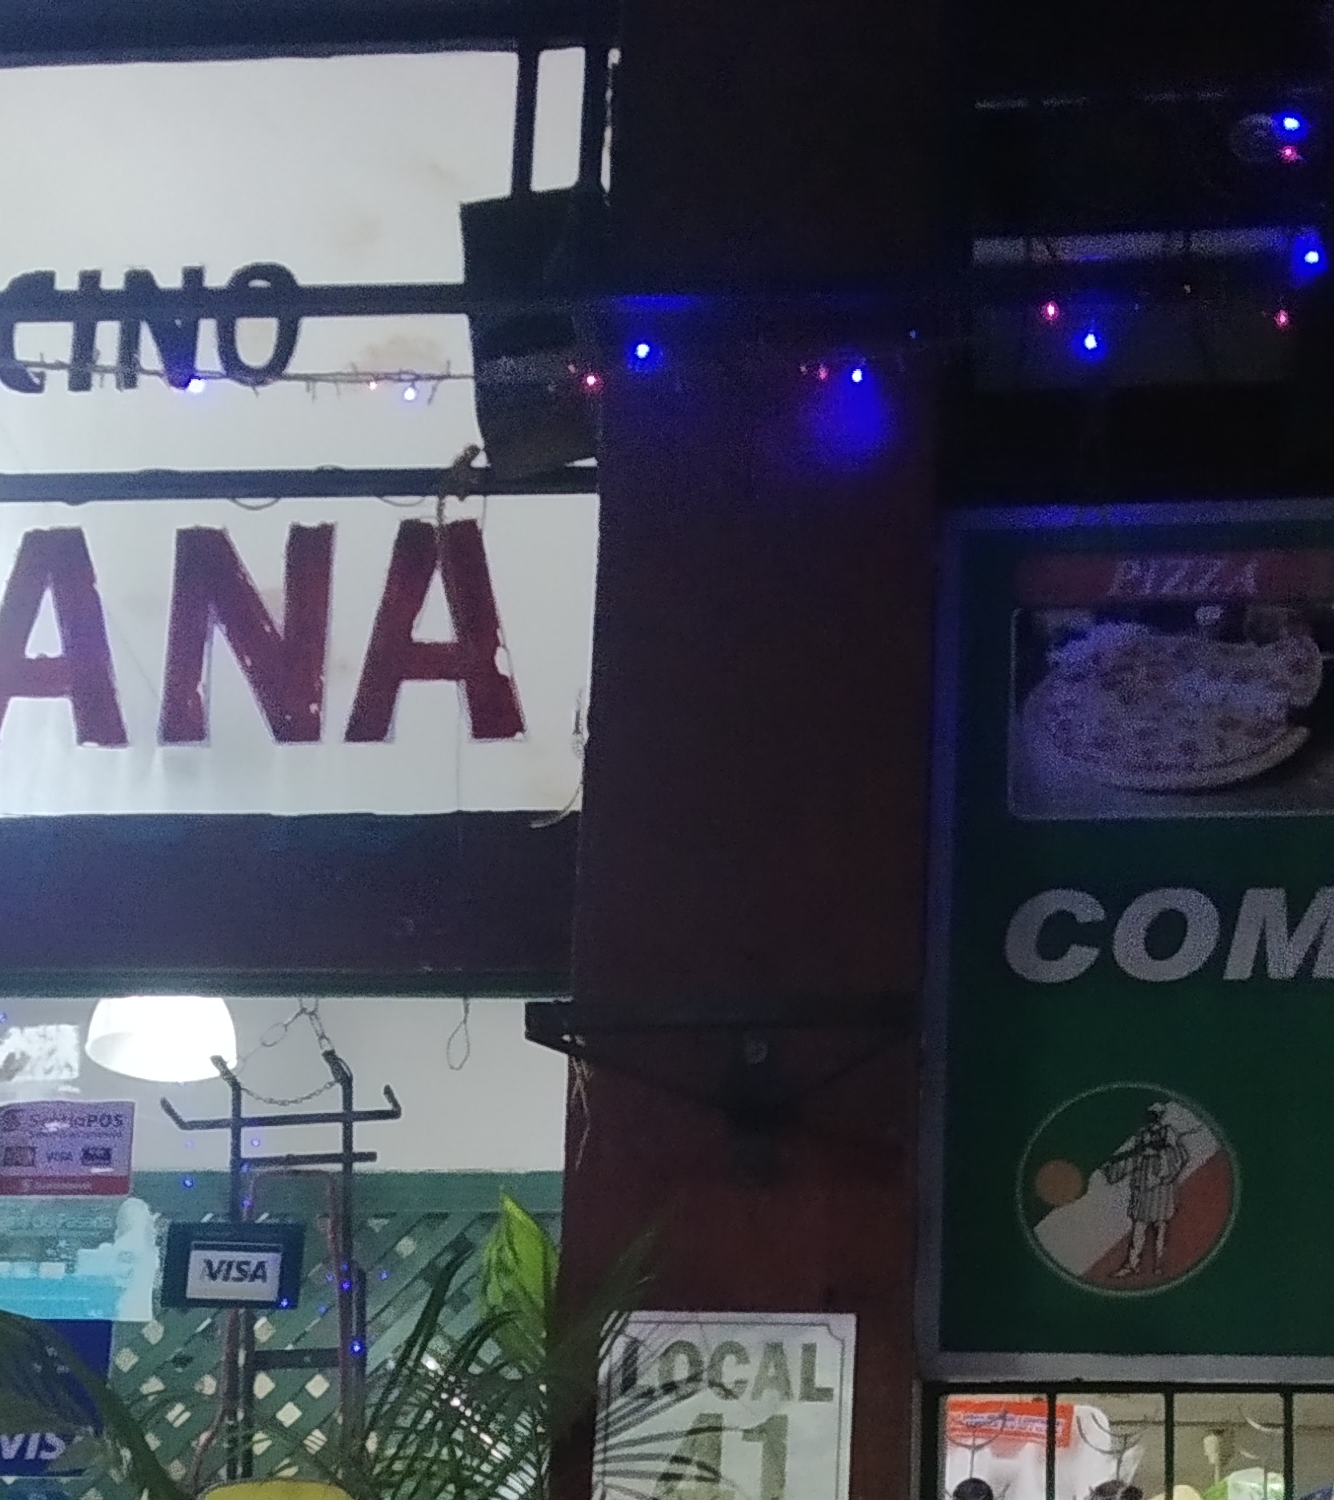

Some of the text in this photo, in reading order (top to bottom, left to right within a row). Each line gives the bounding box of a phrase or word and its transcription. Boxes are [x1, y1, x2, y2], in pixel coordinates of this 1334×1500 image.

[1106, 558, 1260, 597] PIZZA
[204, 1259, 268, 1283] VISA
[619, 1339, 834, 1402] LOCAL
[0, 1432, 66, 1460] VIS
